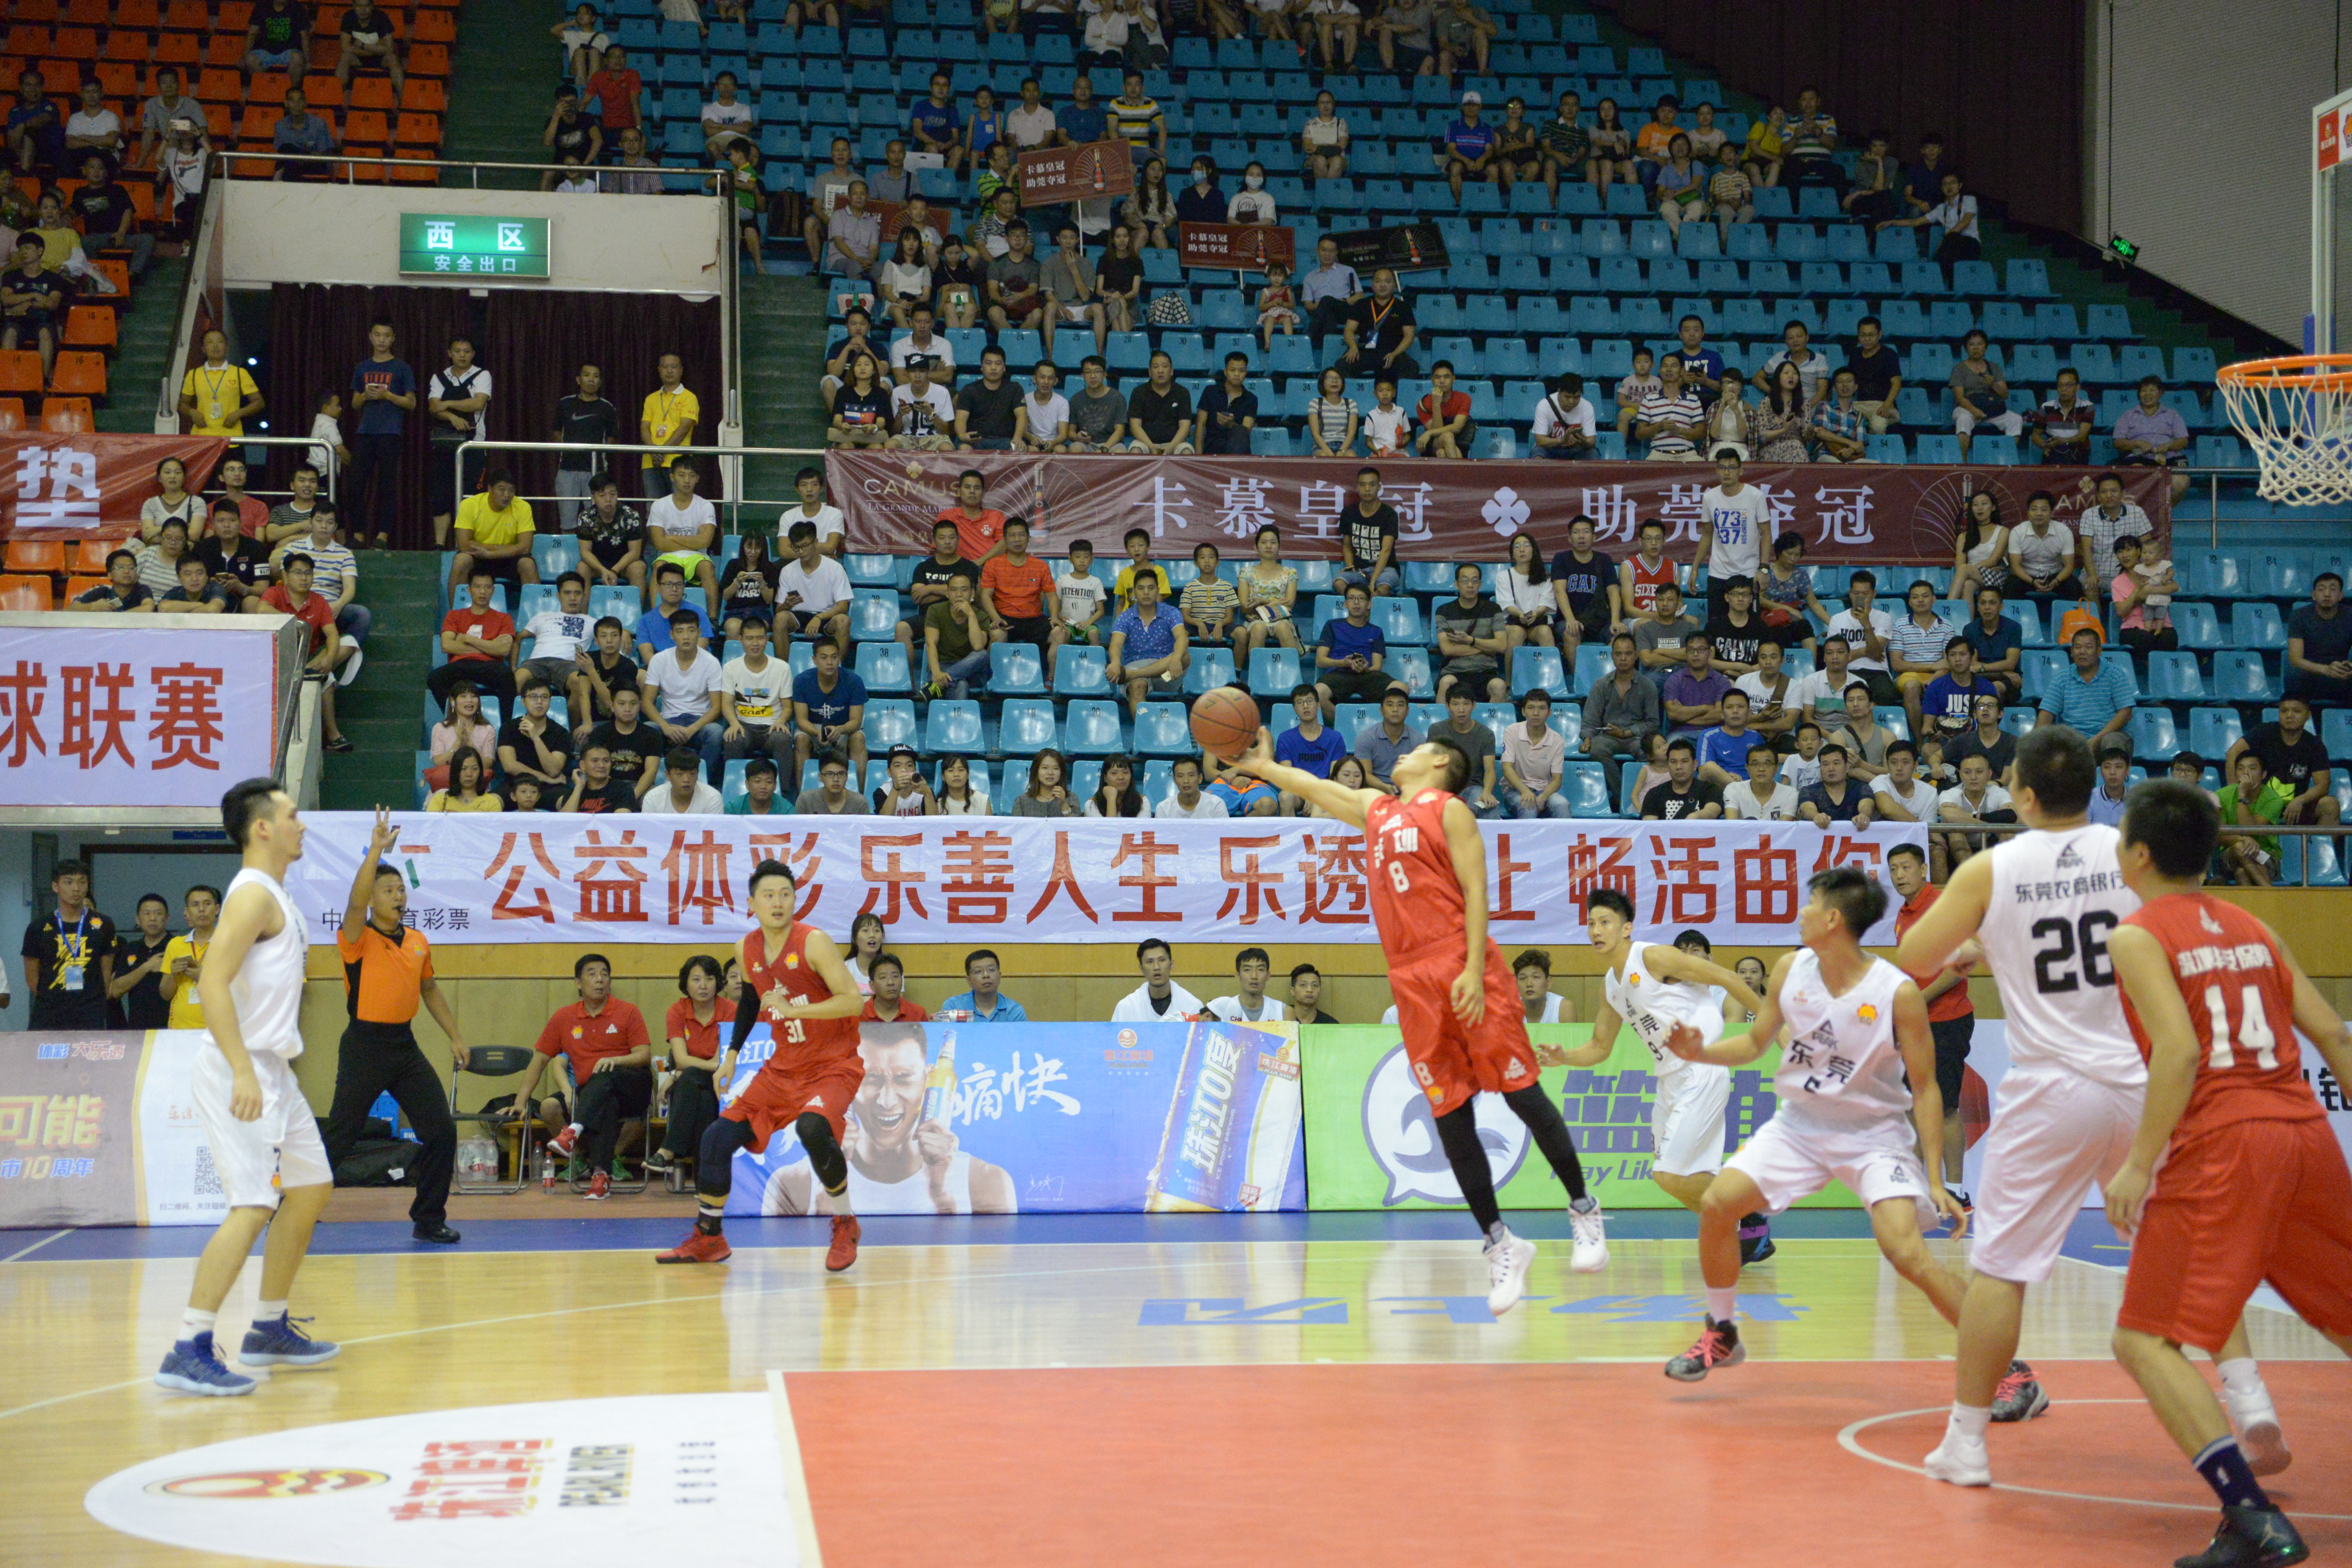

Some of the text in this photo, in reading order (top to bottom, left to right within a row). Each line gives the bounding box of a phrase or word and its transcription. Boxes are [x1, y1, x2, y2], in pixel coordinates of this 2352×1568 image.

[425, 221, 525, 251] 西区
[435, 255, 517, 273] 安全出口
[864, 479, 961, 497] CAMUS
[868, 502, 880, 510] LA
[883, 504, 920, 513] GRANDE
[1134, 475, 1876, 544] 卡慕皇冠 助莞夺冠
[2056, 494, 2136, 509] AMS
[1721, 511, 1741, 526] 73
[1721, 529, 1741, 545] 37
[1635, 584, 1659, 597] SIXE
[1716, 637, 1759, 652] CALVIN
[0, 660, 224, 771] 球联赛
[1298, 753, 1325, 762] PUMA
[580, 798, 605, 809] NIKE
[2057, 857, 2085, 868] PEAK
[485, 830, 824, 926] 公益体彩
[856, 830, 1183, 926] 乐善人生
[1216, 833, 1537, 926] 乐透上
[1388, 860, 1410, 893] 8
[2015, 871, 2128, 903] 东莞农商银行
[322, 908, 470, 932] 中育彩票
[2031, 909, 2121, 994] 26
[784, 1019, 806, 1043] 31
[2203, 984, 2281, 1070] 14
[38, 1040, 126, 1060] 体彩 大乐透
[1811, 1031, 1838, 1050] PEAK
[720, 1038, 777, 1066] 江0
[1262, 1057, 1298, 1076] 珠江啤酒
[1264, 1069, 1293, 1081] PEARL RIVER
[1414, 1061, 1435, 1086] 8
[952, 1051, 1081, 1126] 痛快
[0, 1094, 106, 1149] 可能
[1218, 1143, 1227, 1166] POINT
[1224, 1108, 1236, 1142] BREWING
[1617, 1159, 1655, 1181] Lik
